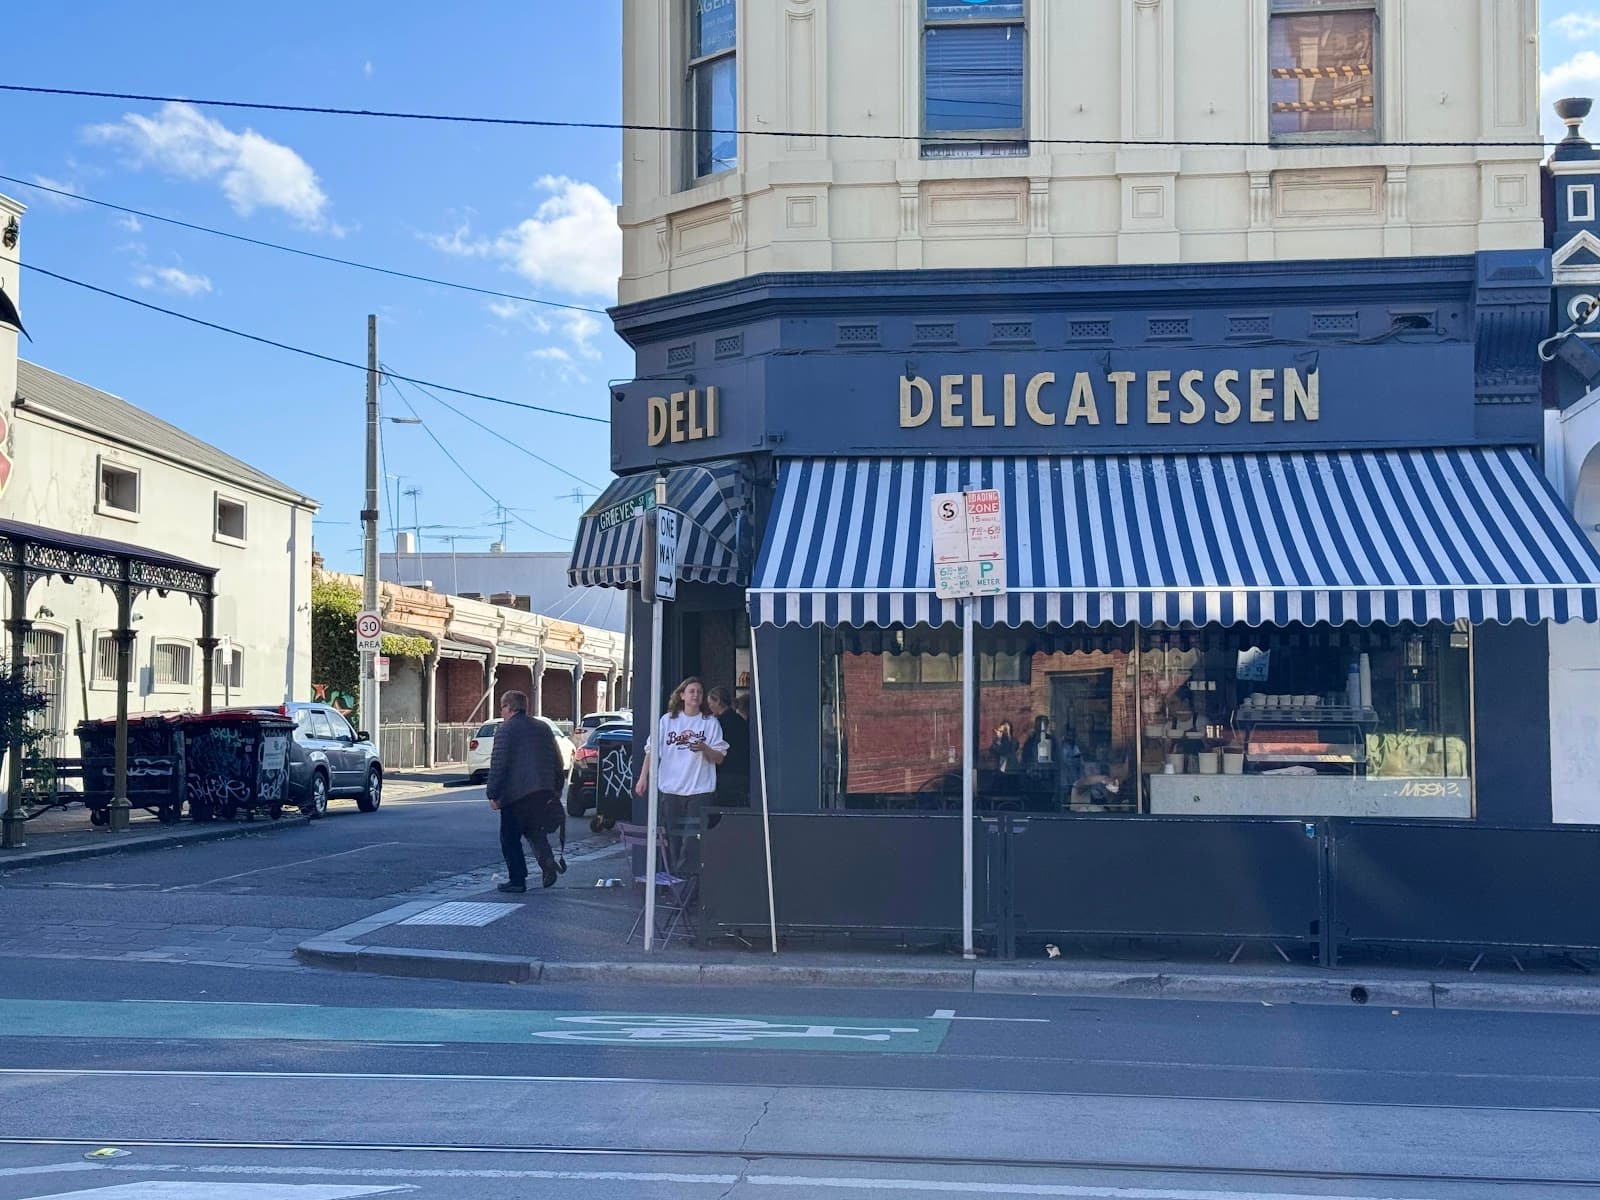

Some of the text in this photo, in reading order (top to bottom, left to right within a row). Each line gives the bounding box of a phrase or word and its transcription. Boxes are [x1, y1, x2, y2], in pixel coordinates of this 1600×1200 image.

[899, 368, 1320, 428] DELICATESSEN
[647, 385, 719, 447] DELI
[600, 500, 635, 530] GREEVES
[968, 502, 999, 514] ZONE
[660, 516, 675, 539] ONE
[659, 544, 675, 566] WAY
[980, 561, 994, 579] P
[361, 621, 377, 632] 30
[358, 640, 380, 649] AREA
